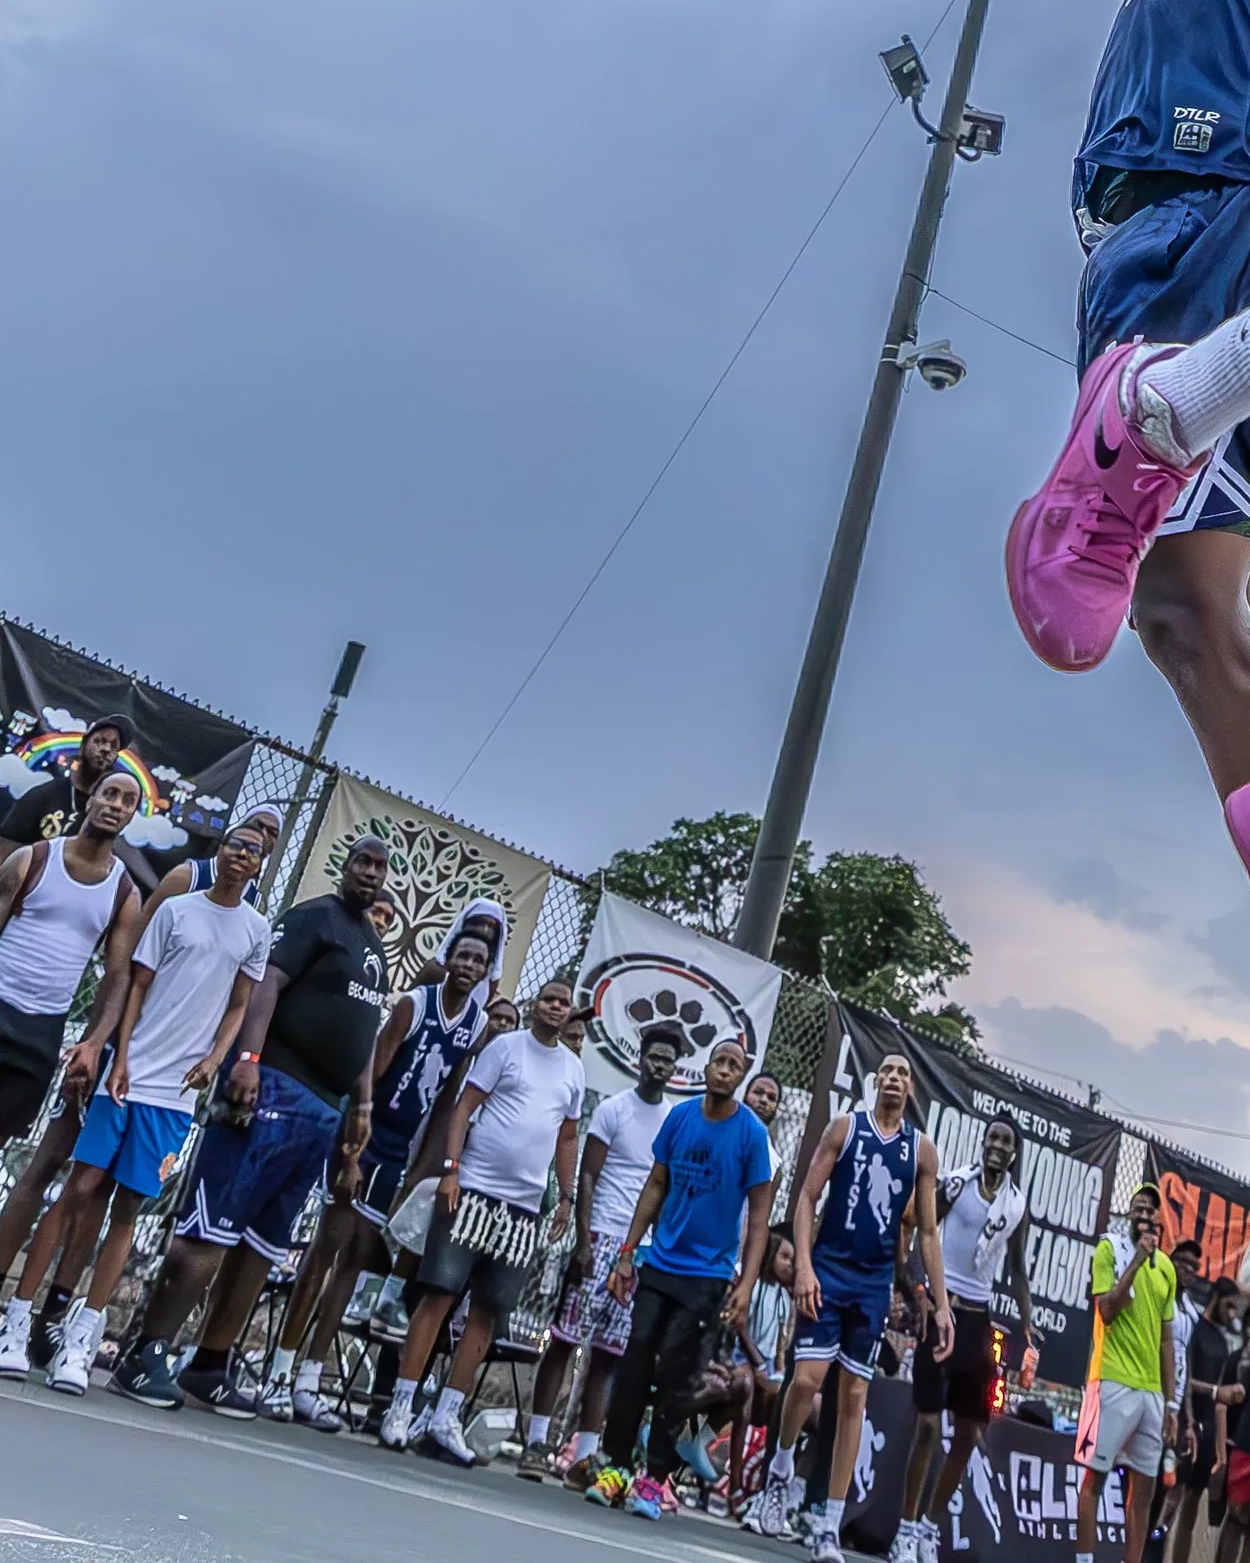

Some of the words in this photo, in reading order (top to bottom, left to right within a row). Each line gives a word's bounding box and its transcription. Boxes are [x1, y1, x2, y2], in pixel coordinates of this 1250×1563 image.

[1173, 106, 1221, 124] DTLR
[453, 1026, 470, 1049] 22
[389, 1030, 428, 1110] LYSL
[900, 1141, 909, 1162] 3
[1032, 1115, 1048, 1137] TO
[1049, 1121, 1072, 1147] THE
[845, 1140, 867, 1231] LYSL
[1020, 1138, 1104, 1237] YOUNG
[1007, 1224, 1096, 1311] EAGUE
